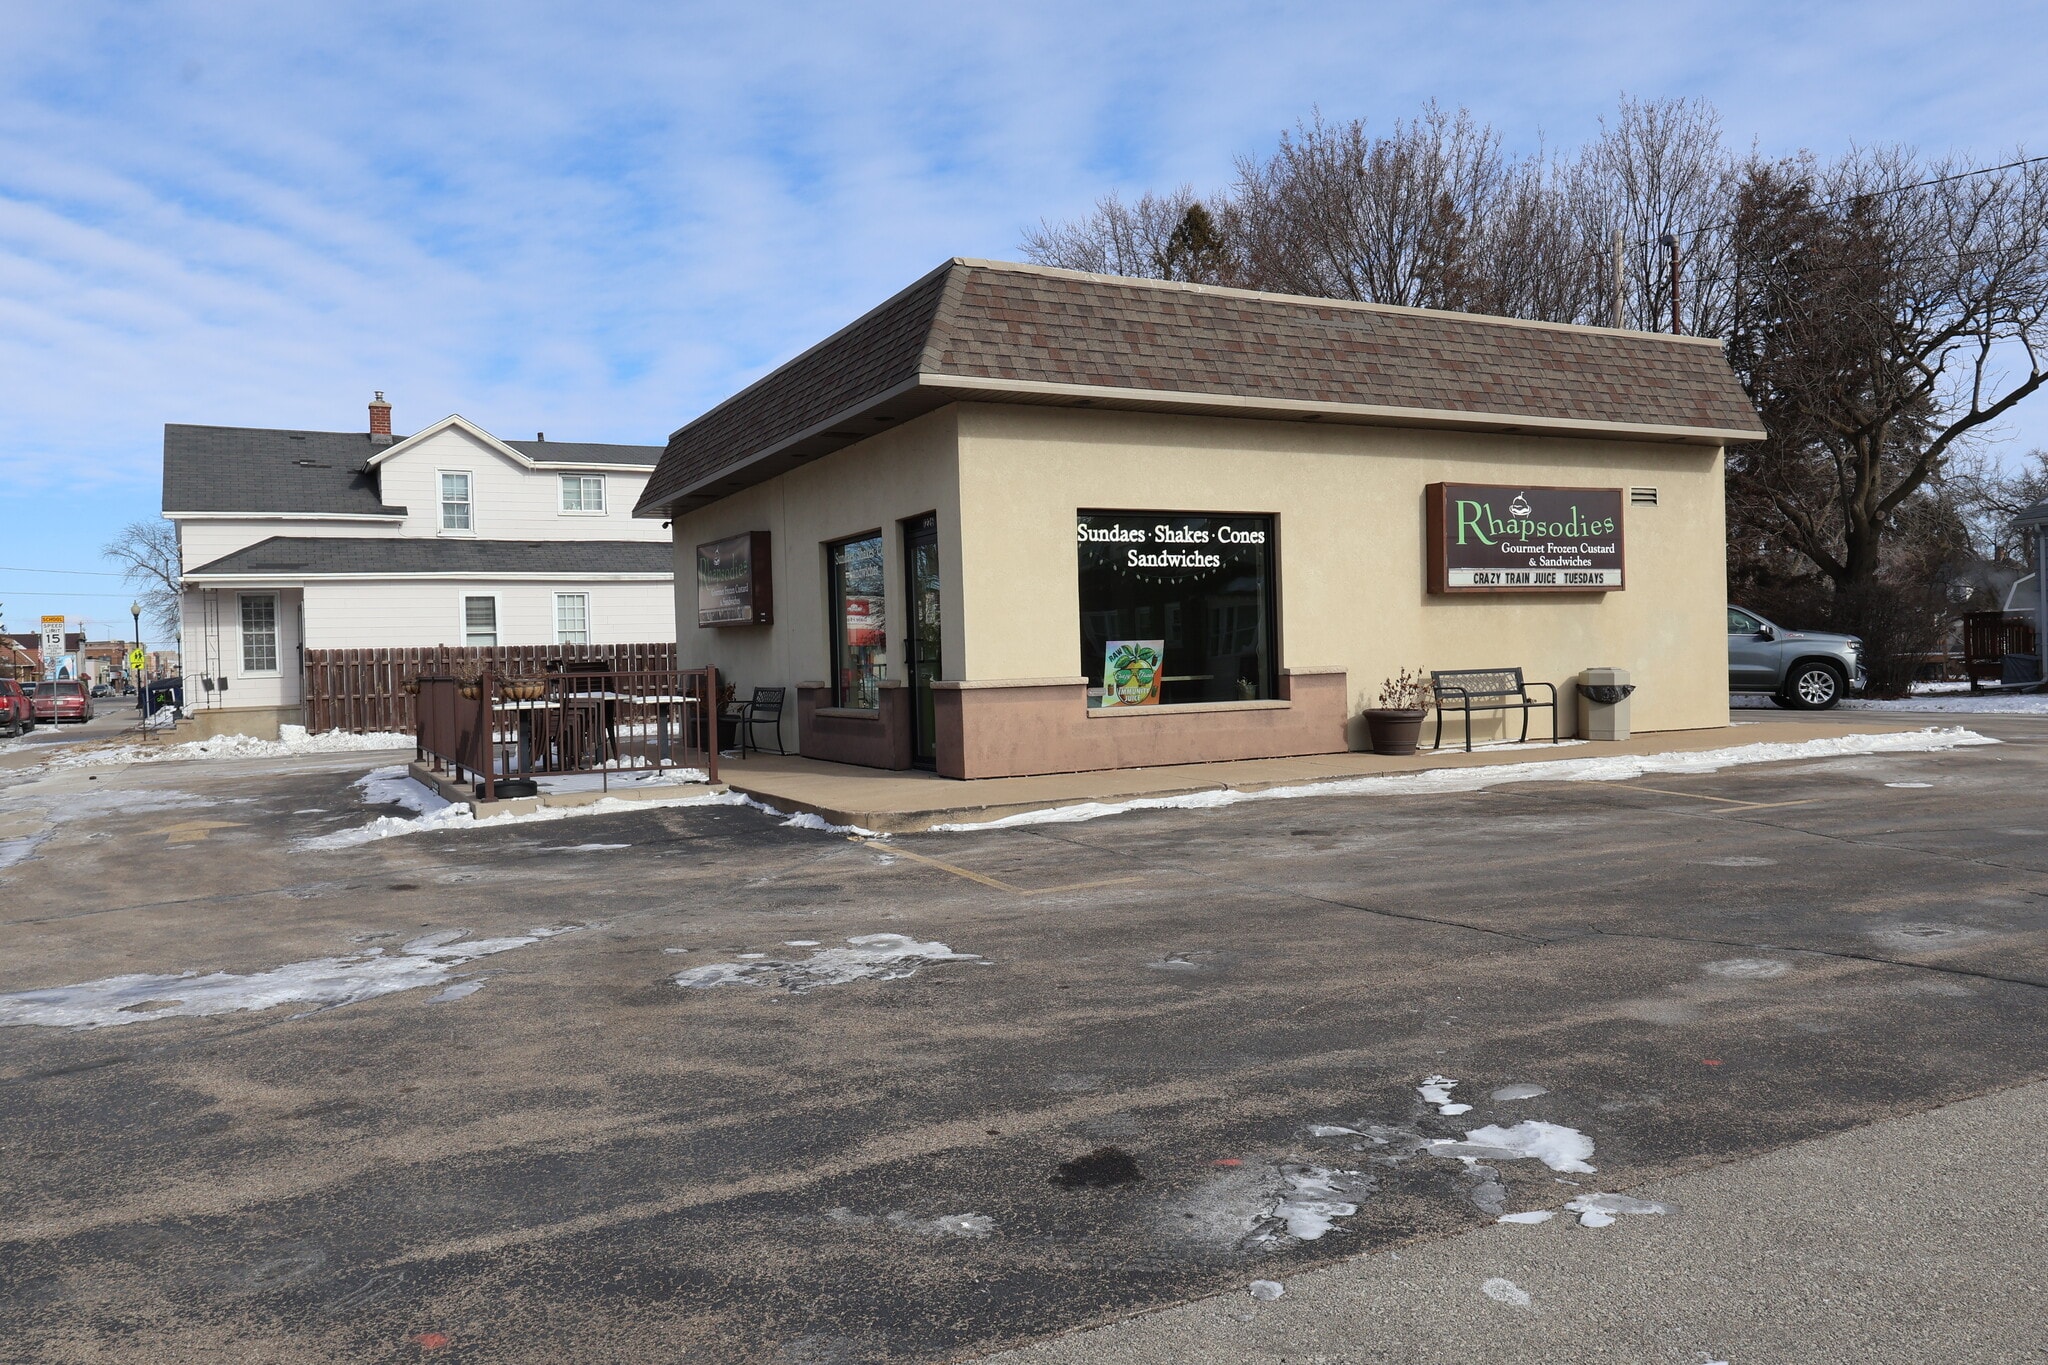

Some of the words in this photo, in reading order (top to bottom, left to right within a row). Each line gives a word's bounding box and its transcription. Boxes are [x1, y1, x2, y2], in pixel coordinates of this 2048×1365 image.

[1455, 500, 1615, 546] Rhapsodies
[1077, 524, 1145, 542] Sundaes
[1154, 525, 1210, 543] Shakes
[1218, 526, 1265, 544] Cones
[1501, 542, 1545, 554] Gourmet
[1547, 543, 1578, 554] Frozen
[1580, 543, 1615, 554] Custard
[1127, 549, 1220, 567] Sandwiches
[1529, 558, 1537, 567] &
[1539, 556, 1592, 567] Sandwiches
[1473, 573, 1501, 584] CRAZY
[1505, 573, 1530, 584] TRAIN
[1533, 573, 1556, 584] JUICE
[1564, 572, 1604, 584] TUESDAYS
[46, 634, 60, 644] 15
[1108, 647, 1123, 662] RAW
[1125, 694, 1141, 703] JUICE
